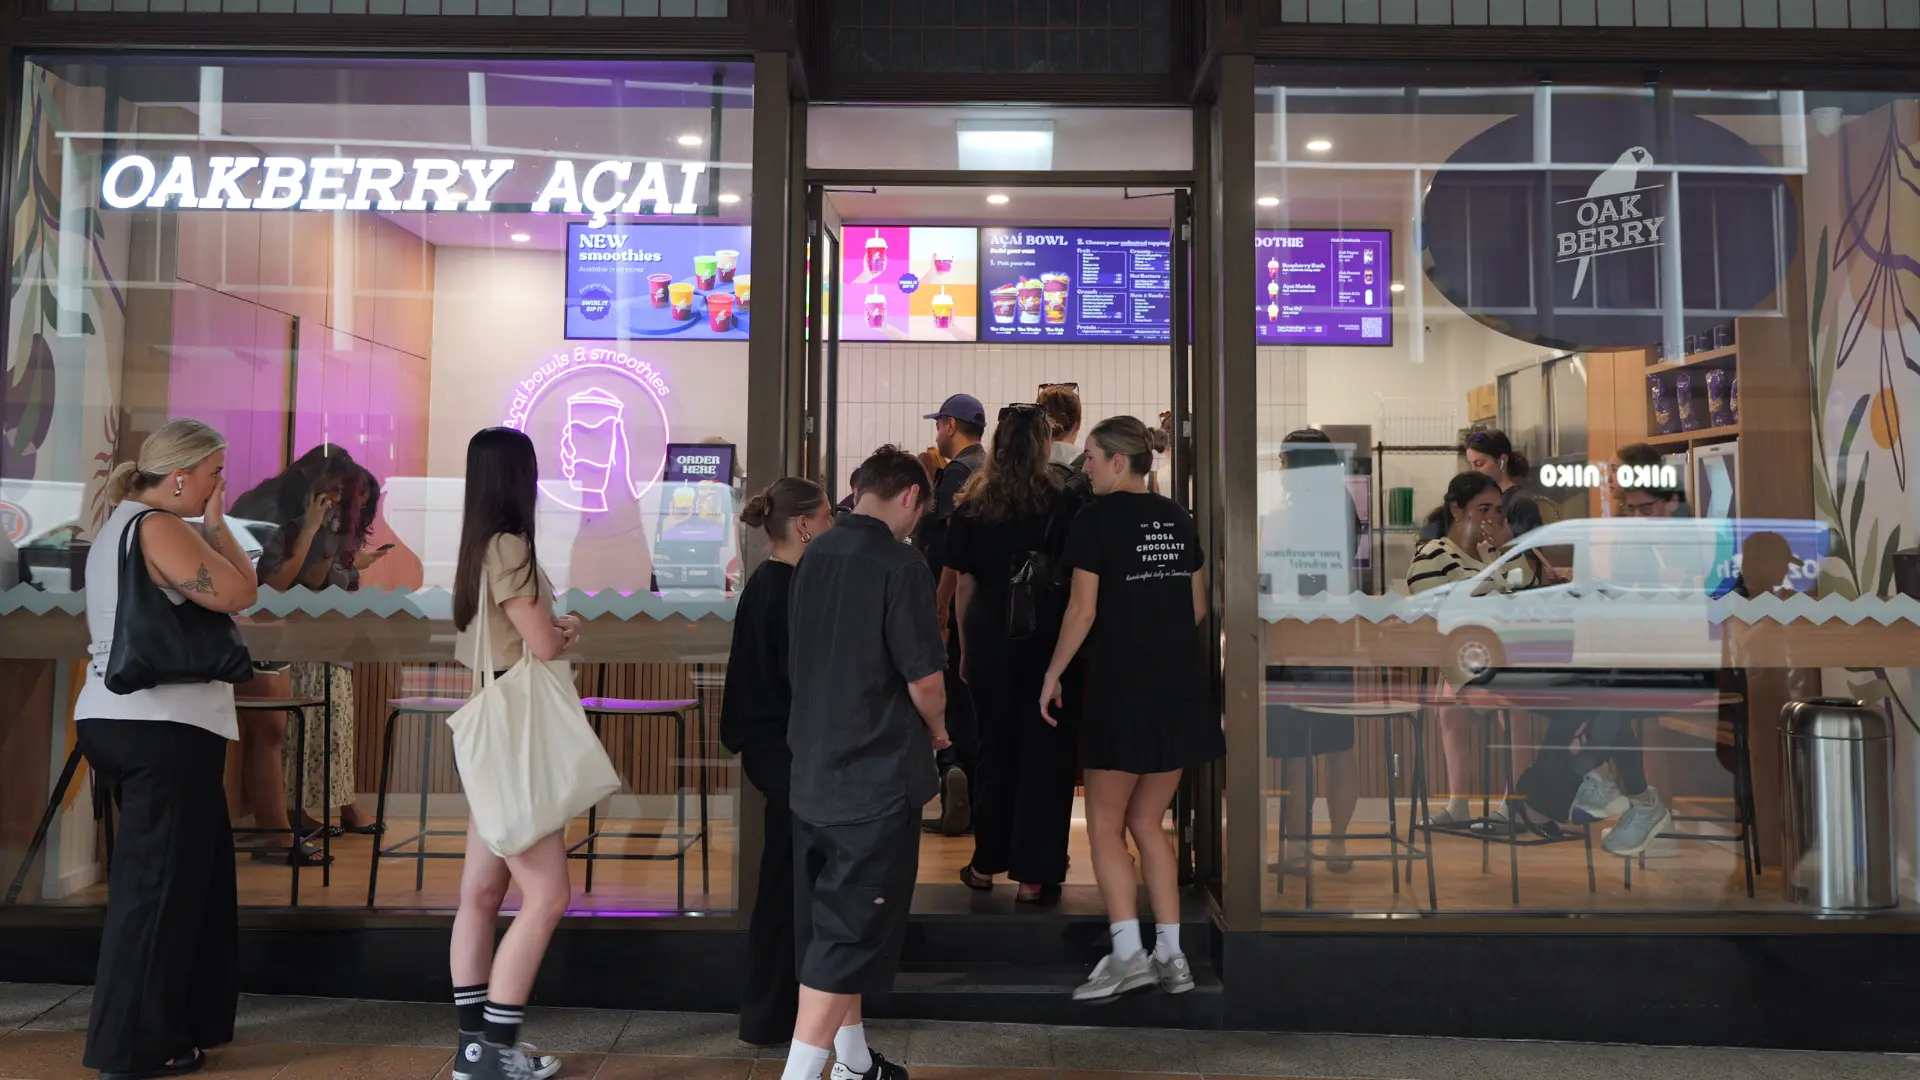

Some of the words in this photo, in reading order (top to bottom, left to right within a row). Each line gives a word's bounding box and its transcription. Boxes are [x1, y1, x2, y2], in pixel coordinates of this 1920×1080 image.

[102, 154, 515, 211] OAKBERRY
[531, 160, 706, 229] AÇAI
[1576, 194, 1643, 226] OAK
[579, 234, 629, 249] NEW
[1026, 235, 1069, 246] BOWL
[1556, 216, 1665, 257] BERRY
[579, 249, 662, 262] smoothies
[520, 352, 569, 392] bowls
[573, 346, 586, 362] &
[590, 348, 671, 397] smoothies
[676, 455, 721, 465] ORDER
[682, 465, 717, 475] HERE
[1145, 533, 1174, 541] NOOSA
[1136, 543, 1185, 552] CHOCOLATE
[1142, 553, 1179, 562] FACTORY
